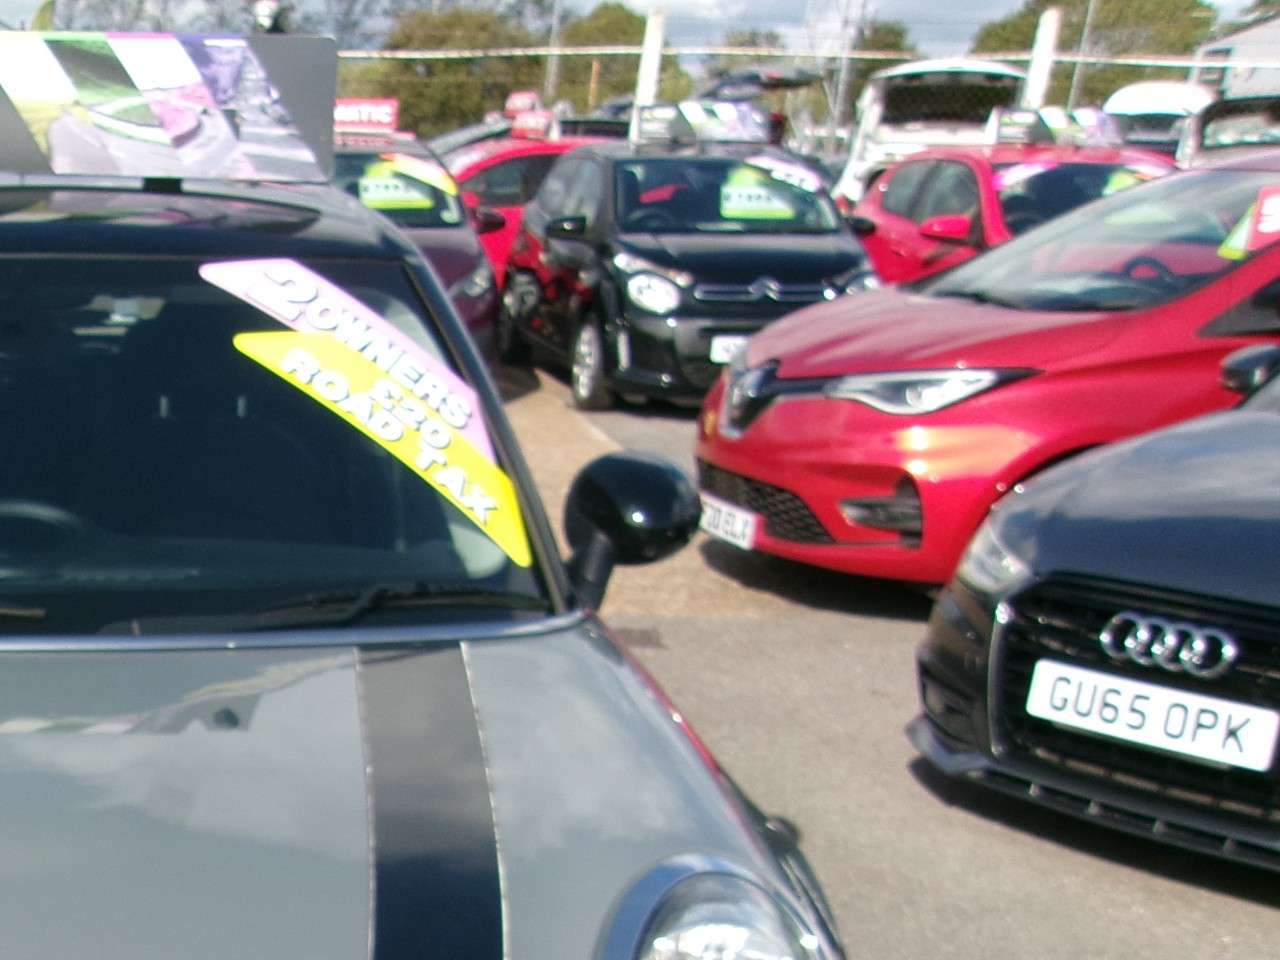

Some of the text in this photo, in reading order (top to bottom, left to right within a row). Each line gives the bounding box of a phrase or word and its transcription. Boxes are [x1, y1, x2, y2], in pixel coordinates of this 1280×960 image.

[306, 299, 473, 431] OWNERS
[374, 379, 453, 450] £20
[279, 349, 498, 525] ROAD TAX
[1049, 674, 1251, 753] GU65 OPK
